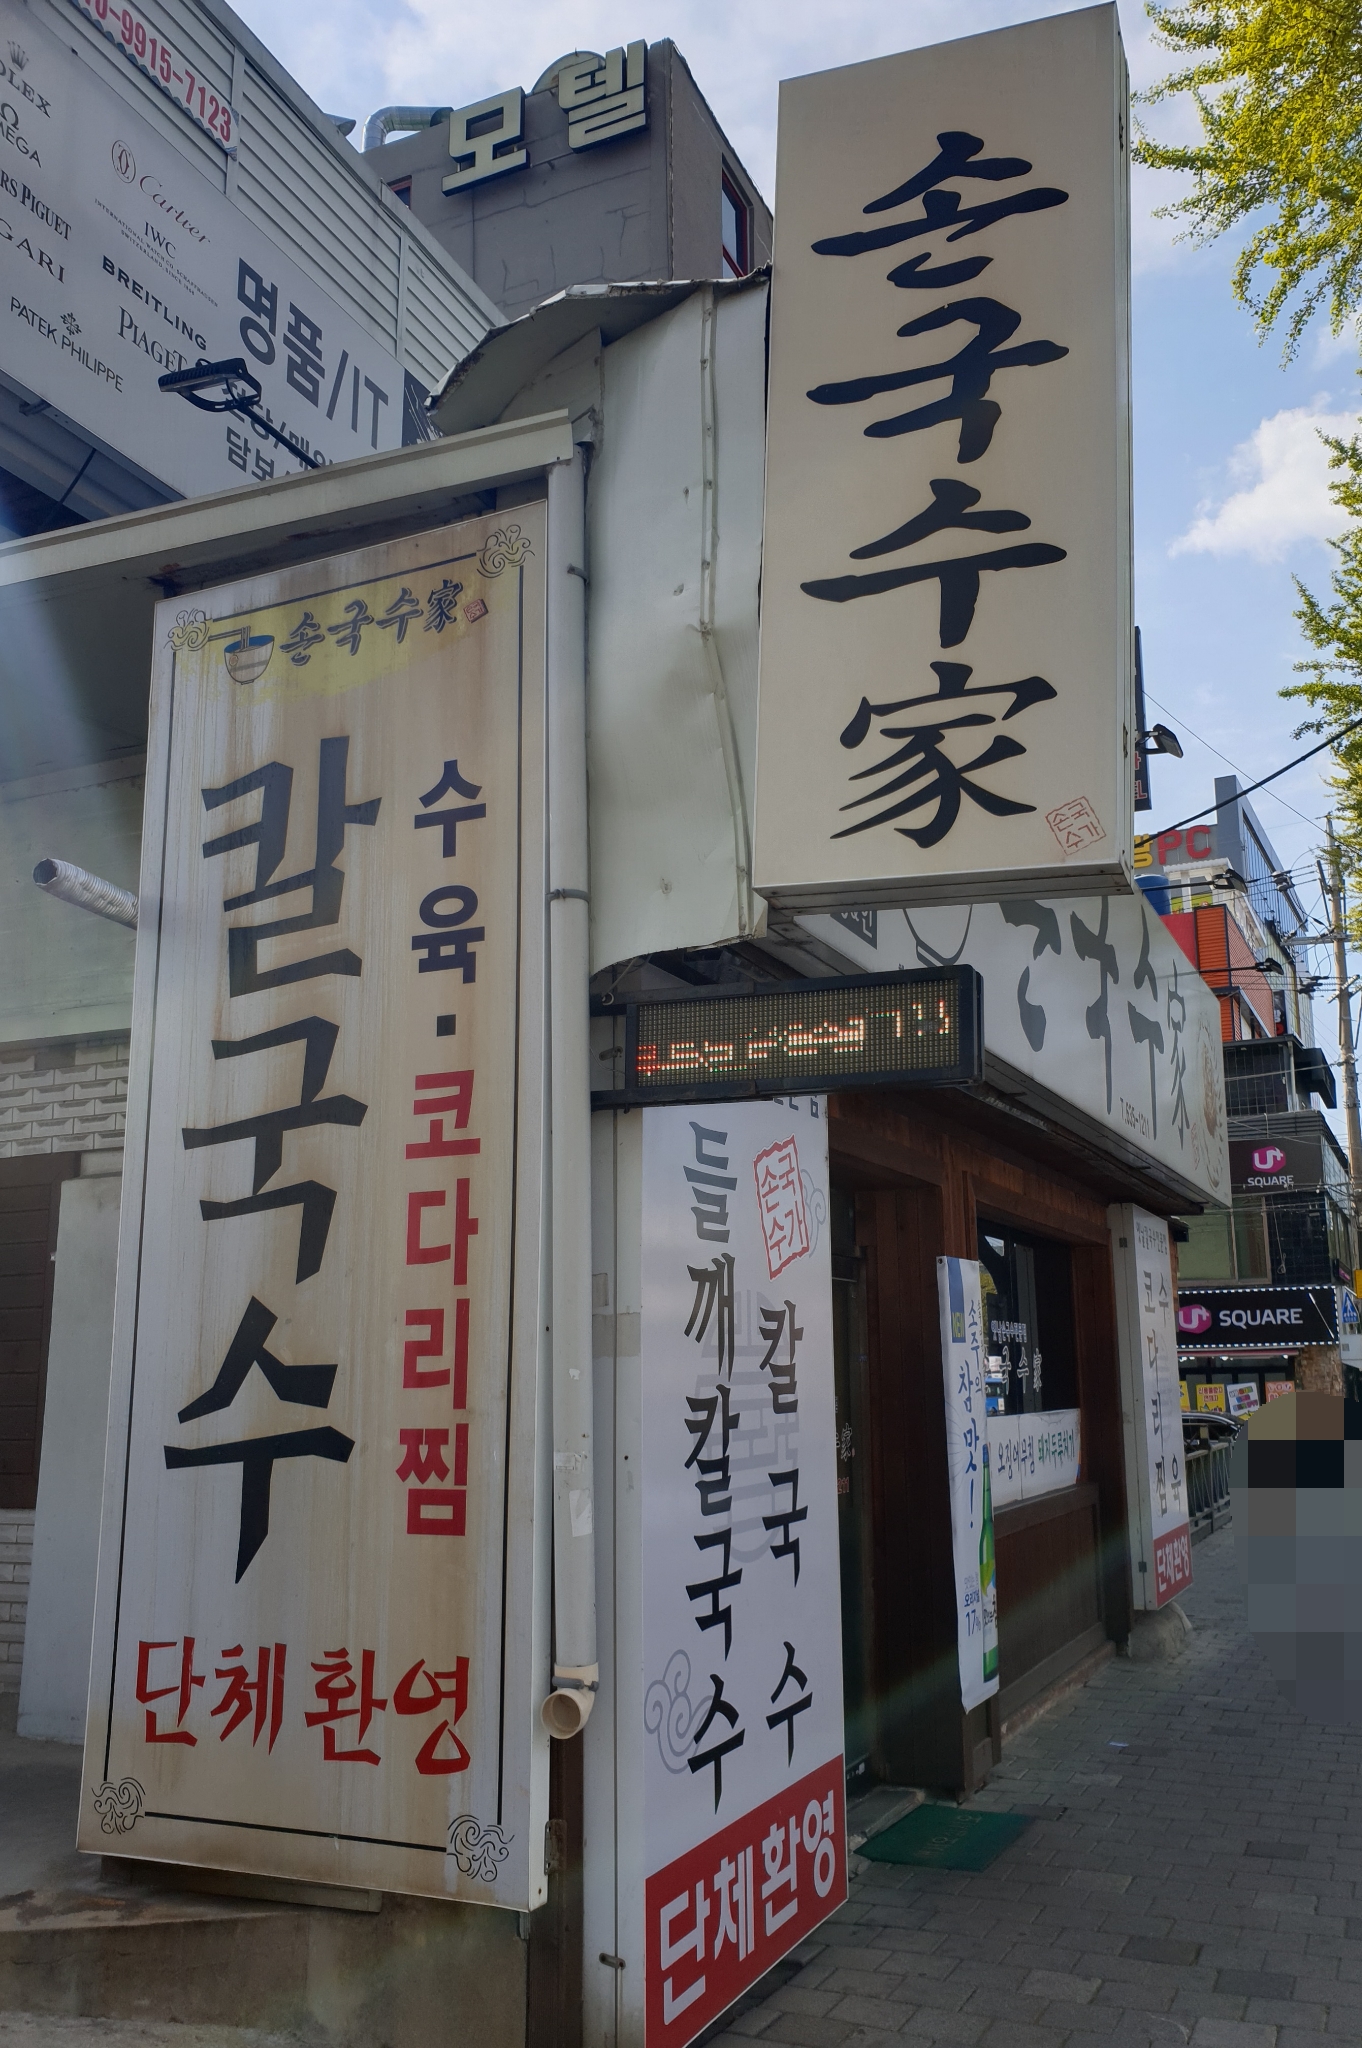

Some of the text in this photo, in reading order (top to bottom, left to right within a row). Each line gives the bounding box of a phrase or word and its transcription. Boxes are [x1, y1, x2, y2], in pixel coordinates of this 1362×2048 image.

[441, 38, 651, 197] 모텔
[20, 182, 71, 240] PIGUET
[94, 198, 144, 244] INTERNATIONAL
[139, 175, 211, 243] Cartier
[144, 220, 176, 259] IWC
[10, 296, 123, 393] PATEK PHILIPPE
[102, 254, 207, 351] BREITLING
[118, 305, 187, 373] PIAGET
[237, 257, 389, 450] 명품/IT
[801, 131, 1069, 848] 손국수家
[164, 735, 382, 1584] 칼국수
[1247, 1174, 1294, 1188] SQUARE
[395, 1069, 482, 1536] 코다리찜
[952, 1311, 965, 1338] NEW
[968, 1299, 984, 1397] 소주의
[1218, 1307, 1303, 1330] SQUARE
[1143, 1270, 1168, 1518] 코다리찜
[683, 1121, 745, 1815] 들깨칼국수
[997, 1435, 1035, 1480] 오징어무침
[759, 1300, 812, 1767] 칼국수
